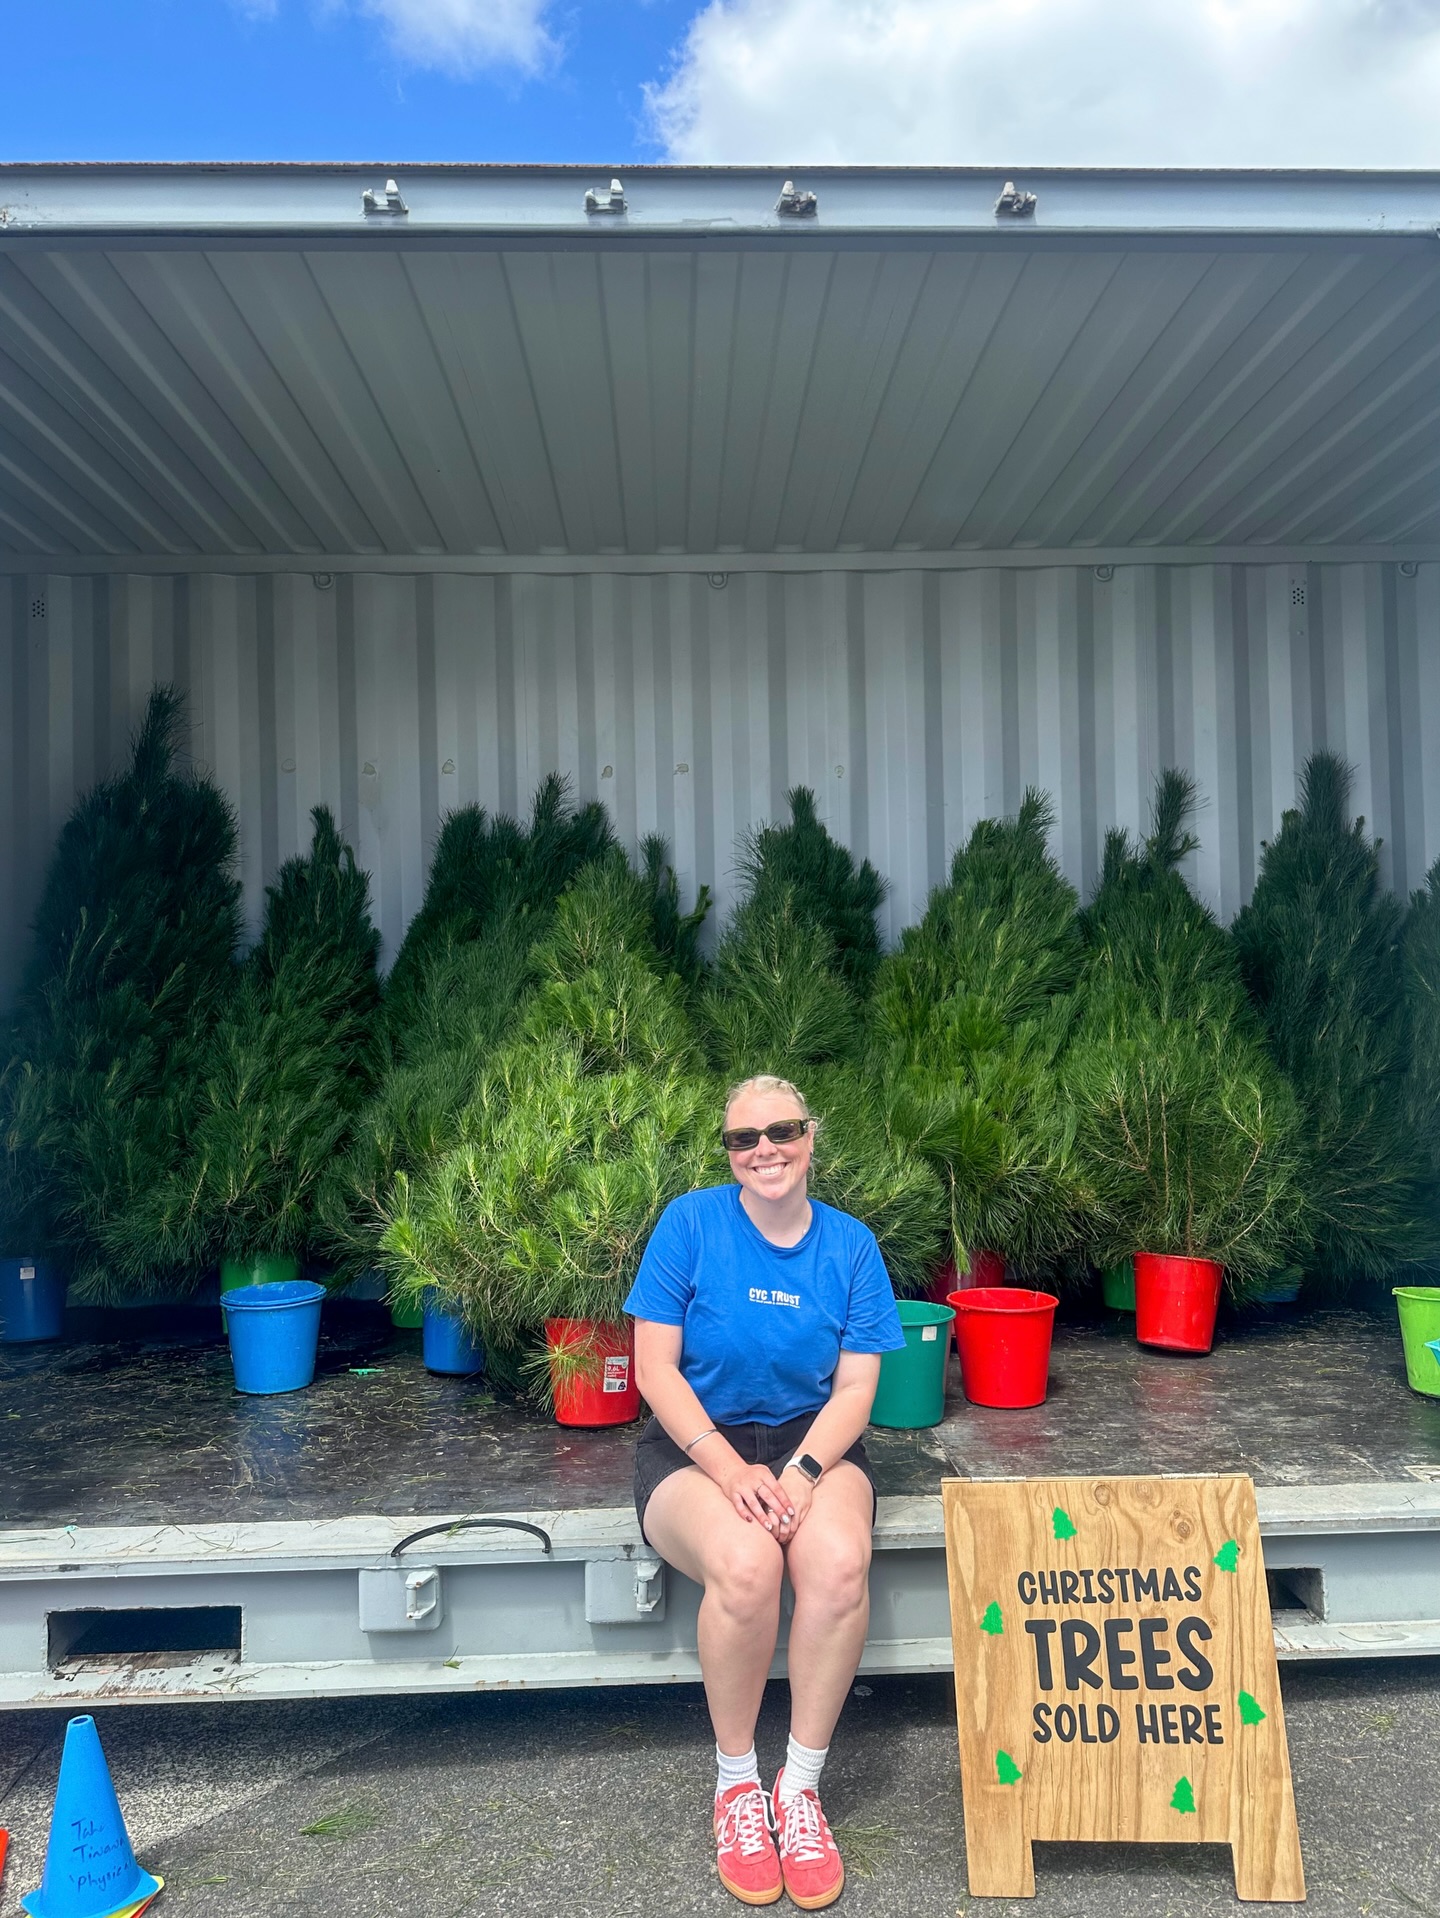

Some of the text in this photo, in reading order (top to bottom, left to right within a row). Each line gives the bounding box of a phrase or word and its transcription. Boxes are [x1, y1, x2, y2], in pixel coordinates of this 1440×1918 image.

[749, 1287, 768, 1300] CYC
[771, 1290, 801, 1305] TRUST
[1017, 1566, 1202, 1605] CHRISTMAS
[1024, 1616, 1214, 1692] TREES
[1032, 1702, 1224, 1745] SOLD HERE
